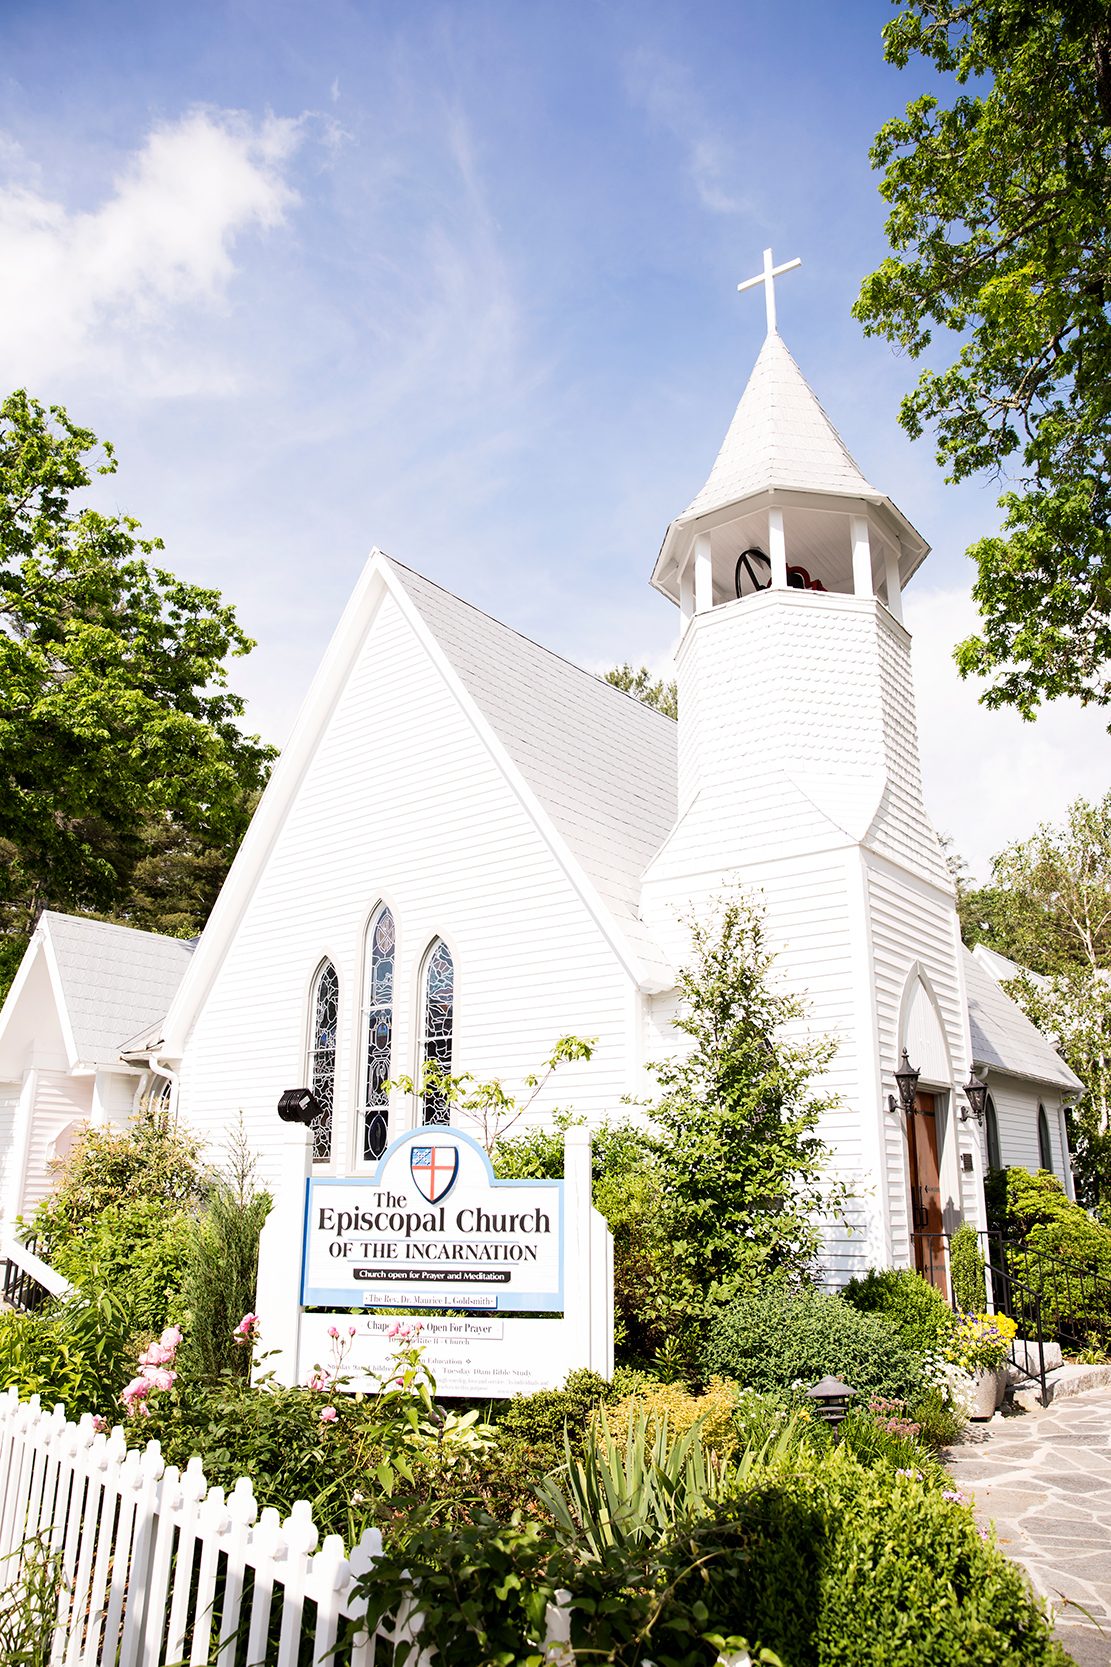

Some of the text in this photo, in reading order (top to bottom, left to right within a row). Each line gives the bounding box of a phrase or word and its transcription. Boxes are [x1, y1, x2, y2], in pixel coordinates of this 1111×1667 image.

[373, 1191, 408, 1208] The
[318, 1205, 551, 1238] Episcopal Church
[329, 1241, 537, 1261] OF THE INCARNATION
[359, 1270, 386, 1279] Church
[388, 1272, 407, 1280] open
[409, 1271, 420, 1279] for
[421, 1271, 445, 1281] Prayer
[463, 1273, 505, 1281] Meditation
[369, 1294, 382, 1303] The
[384, 1295, 399, 1303] Rev.
[400, 1295, 412, 1304] Dr.
[413, 1296, 442, 1304] Maurice
[452, 1296, 491, 1306] Goldsmith
[366, 1320, 393, 1332] Chape
[426, 1322, 447, 1334] Open
[449, 1323, 463, 1333] For
[465, 1323, 493, 1335] Prayer
[443, 1367, 471, 1376] Tuesday
[512, 1370, 532, 1378] Study
